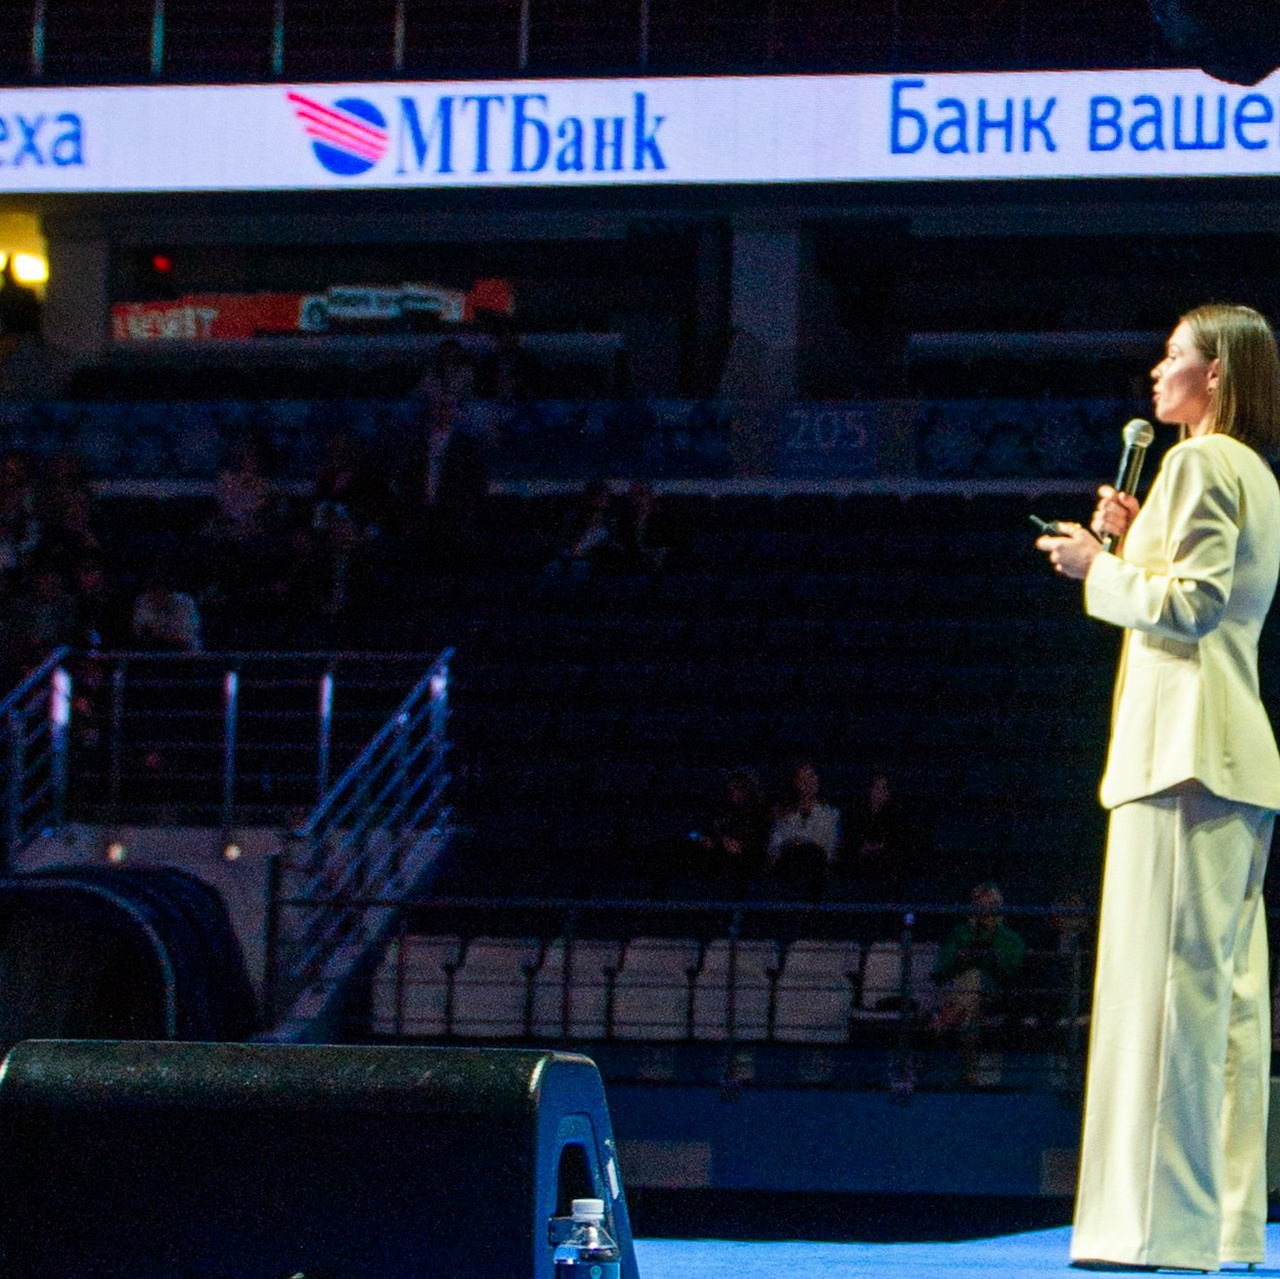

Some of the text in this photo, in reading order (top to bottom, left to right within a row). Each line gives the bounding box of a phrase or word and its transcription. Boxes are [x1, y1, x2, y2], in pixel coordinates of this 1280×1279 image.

[0, 112, 84, 166] ха
[396, 91, 669, 175] МТБанк
[887, 77, 1058, 156] Банк
